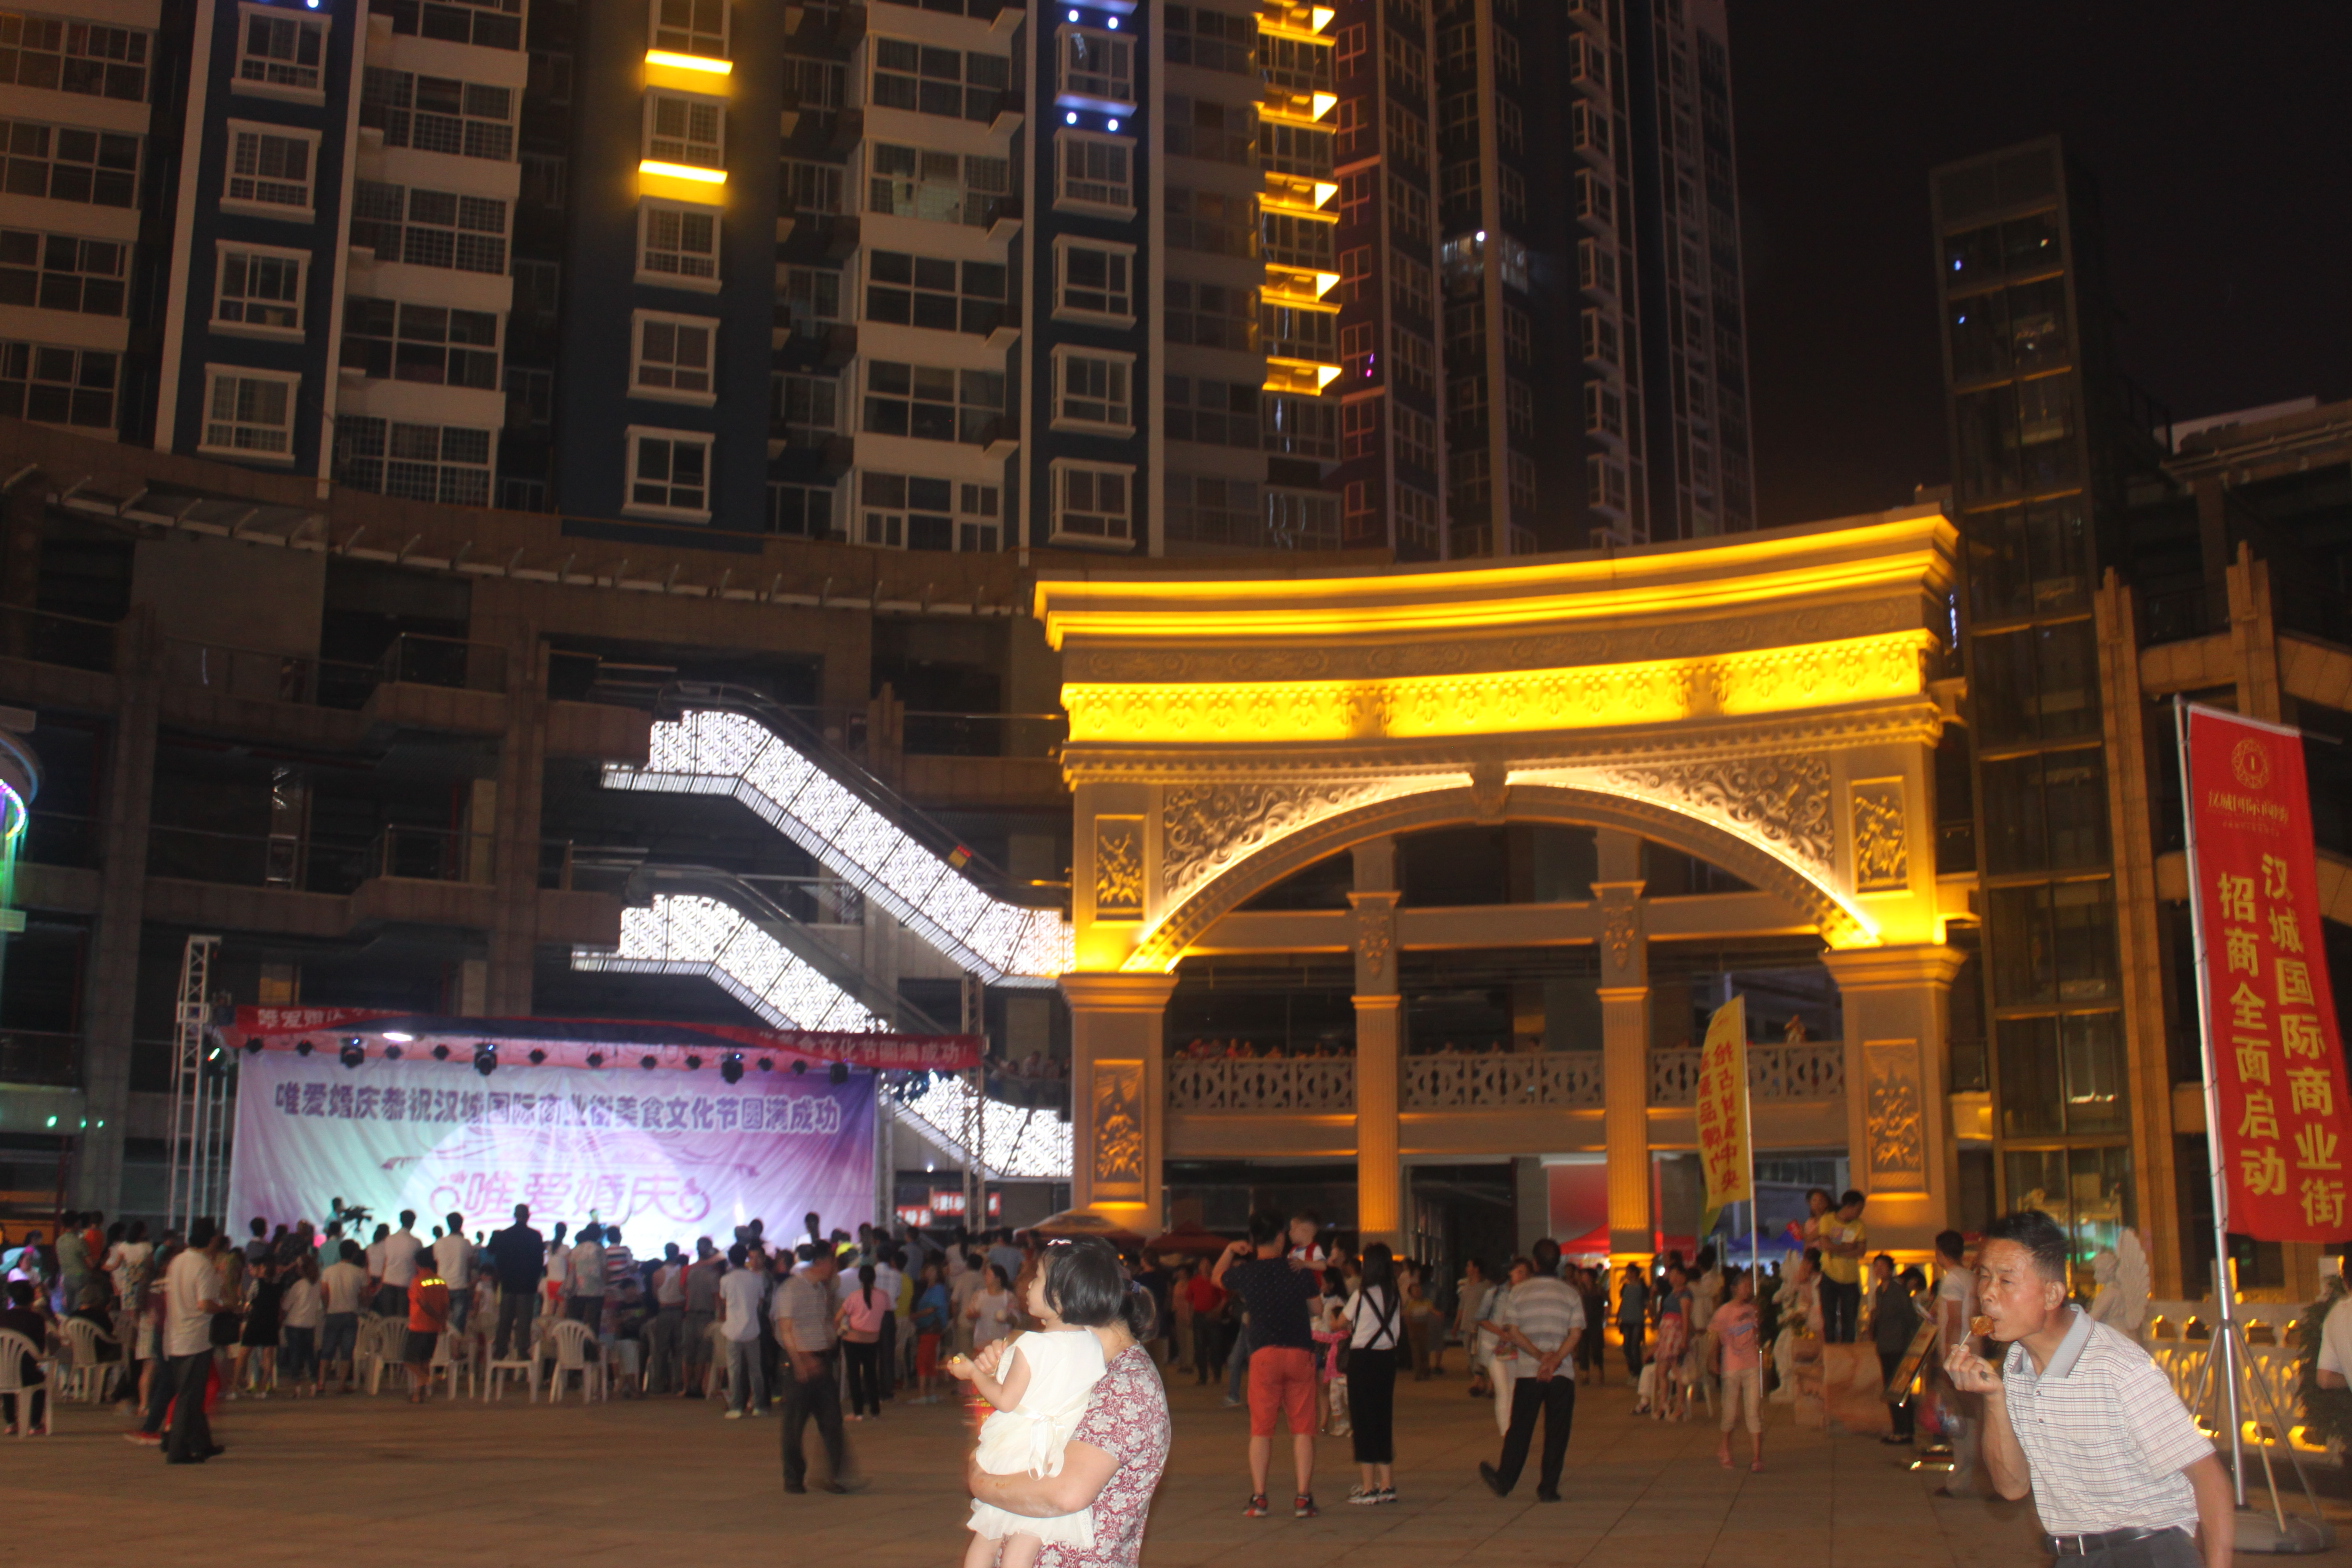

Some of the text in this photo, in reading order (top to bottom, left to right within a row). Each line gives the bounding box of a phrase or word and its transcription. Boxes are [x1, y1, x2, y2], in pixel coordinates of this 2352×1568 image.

[275, 1081, 842, 1135] 唯爱婚庆恭祝汉城国际商业街美食文化节圆满成功
[2218, 871, 2288, 1197] 招商全面启动
[2261, 852, 2347, 1228] 汉城国际商业街
[465, 1169, 683, 1220] 唯爱婚庆
